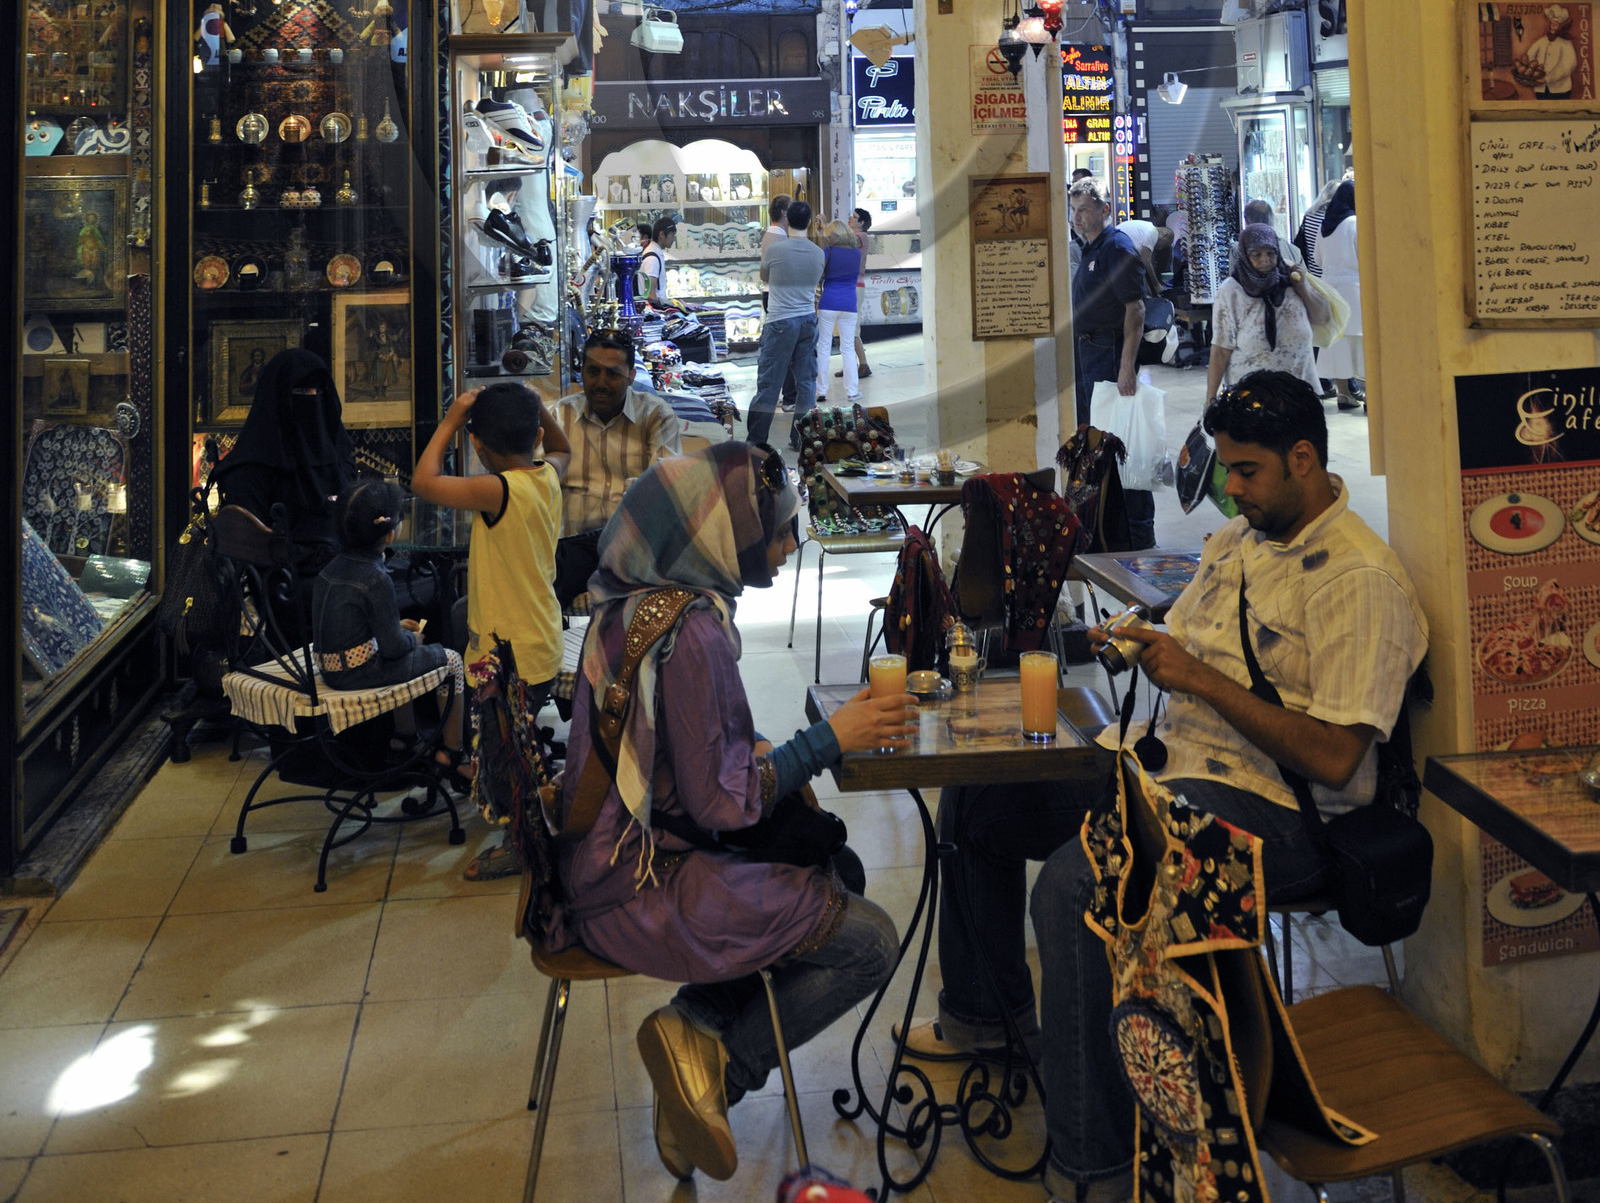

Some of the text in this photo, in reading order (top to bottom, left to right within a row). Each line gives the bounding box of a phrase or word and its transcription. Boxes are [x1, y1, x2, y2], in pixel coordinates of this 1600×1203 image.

[1507, 5, 1544, 15] BISTRO
[1579, 5, 1592, 99] TOSCANA
[1075, 60, 1109, 74] Sarrafiye
[1065, 75, 1107, 91] ALTIN
[628, 85, 789, 122] NAKŞİLER
[975, 91, 1025, 104] SİGARA
[812, 109, 825, 119] 98
[973, 105, 1027, 122] İÇİLMEZ
[1086, 118, 1111, 129] GRAM
[1087, 131, 1111, 142] ALTIN
[1519, 142, 1545, 150] CAFE
[1503, 575, 1539, 591] Soup
[1499, 937, 1574, 961] Sandwich
